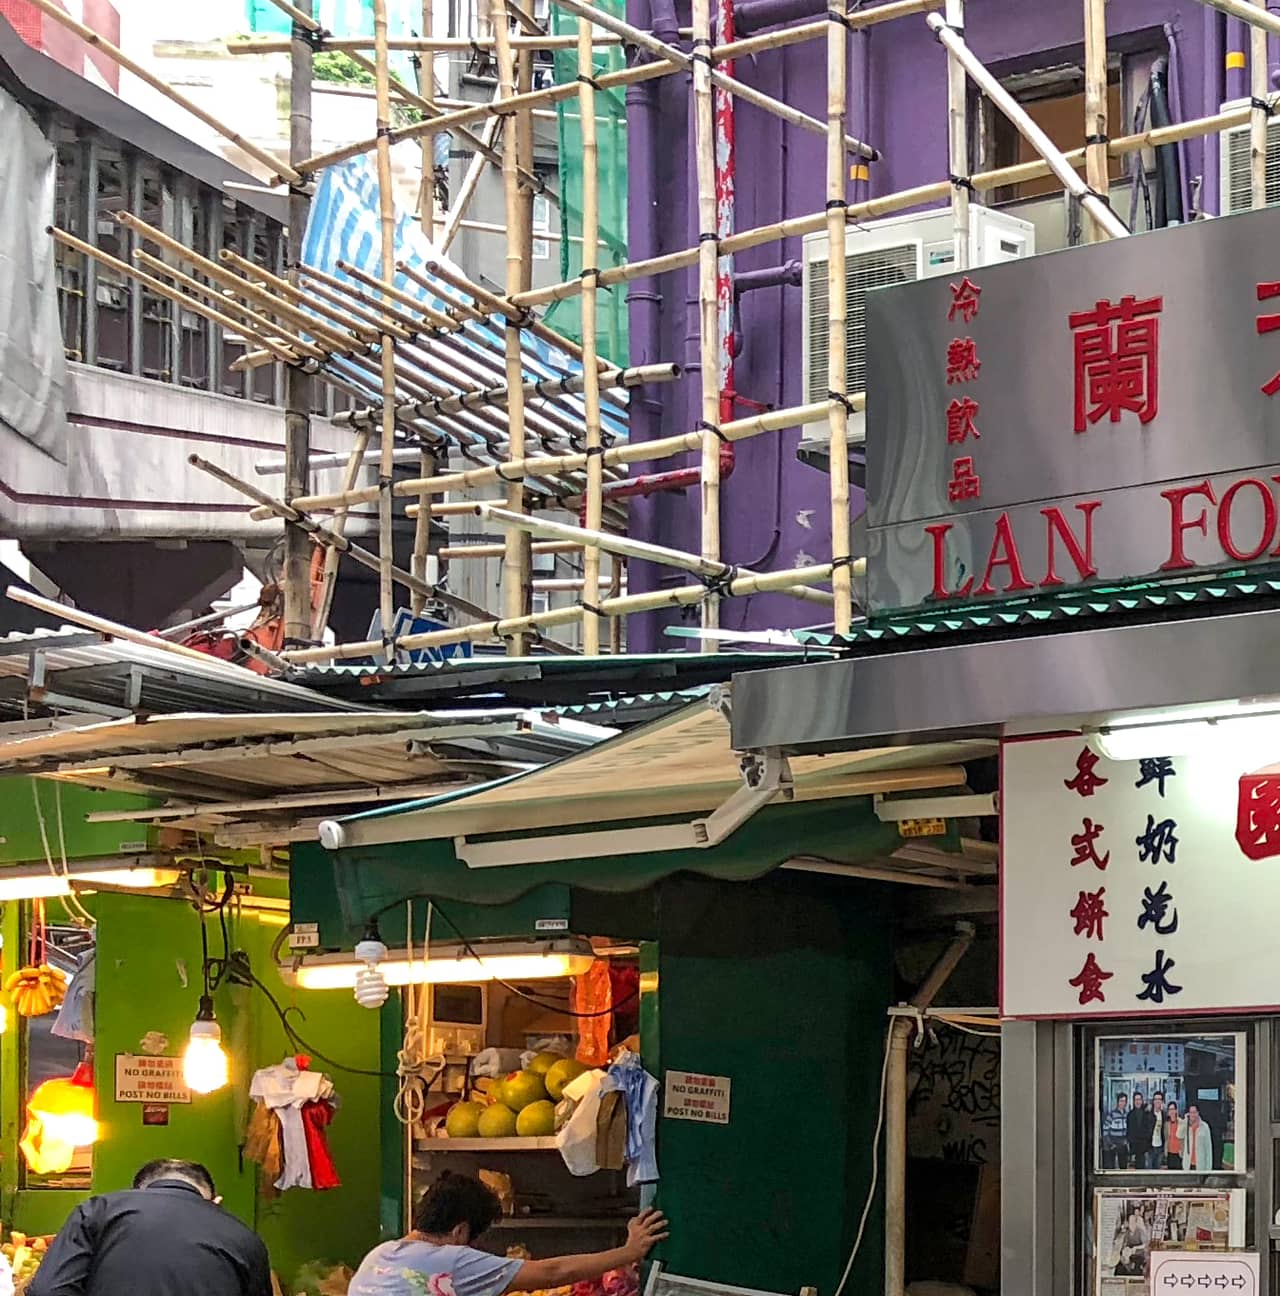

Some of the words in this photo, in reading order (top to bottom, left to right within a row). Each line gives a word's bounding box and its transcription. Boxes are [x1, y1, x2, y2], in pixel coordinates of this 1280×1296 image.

[944, 274, 984, 503] 冷熱飲品
[924, 500, 1103, 600] LAN
[1063, 744, 1114, 1006] 各式餅食
[124, 1068, 140, 1077] NO
[119, 1090, 145, 1099] POST
[146, 1091, 161, 1099] NO
[163, 1091, 188, 1100] BILLS
[672, 1084, 686, 1093] NO
[688, 1086, 725, 1097] GRAFFITI
[667, 1106, 689, 1116] POST
[690, 1109, 704, 1117] NO
[705, 1110, 727, 1120] BILLS
